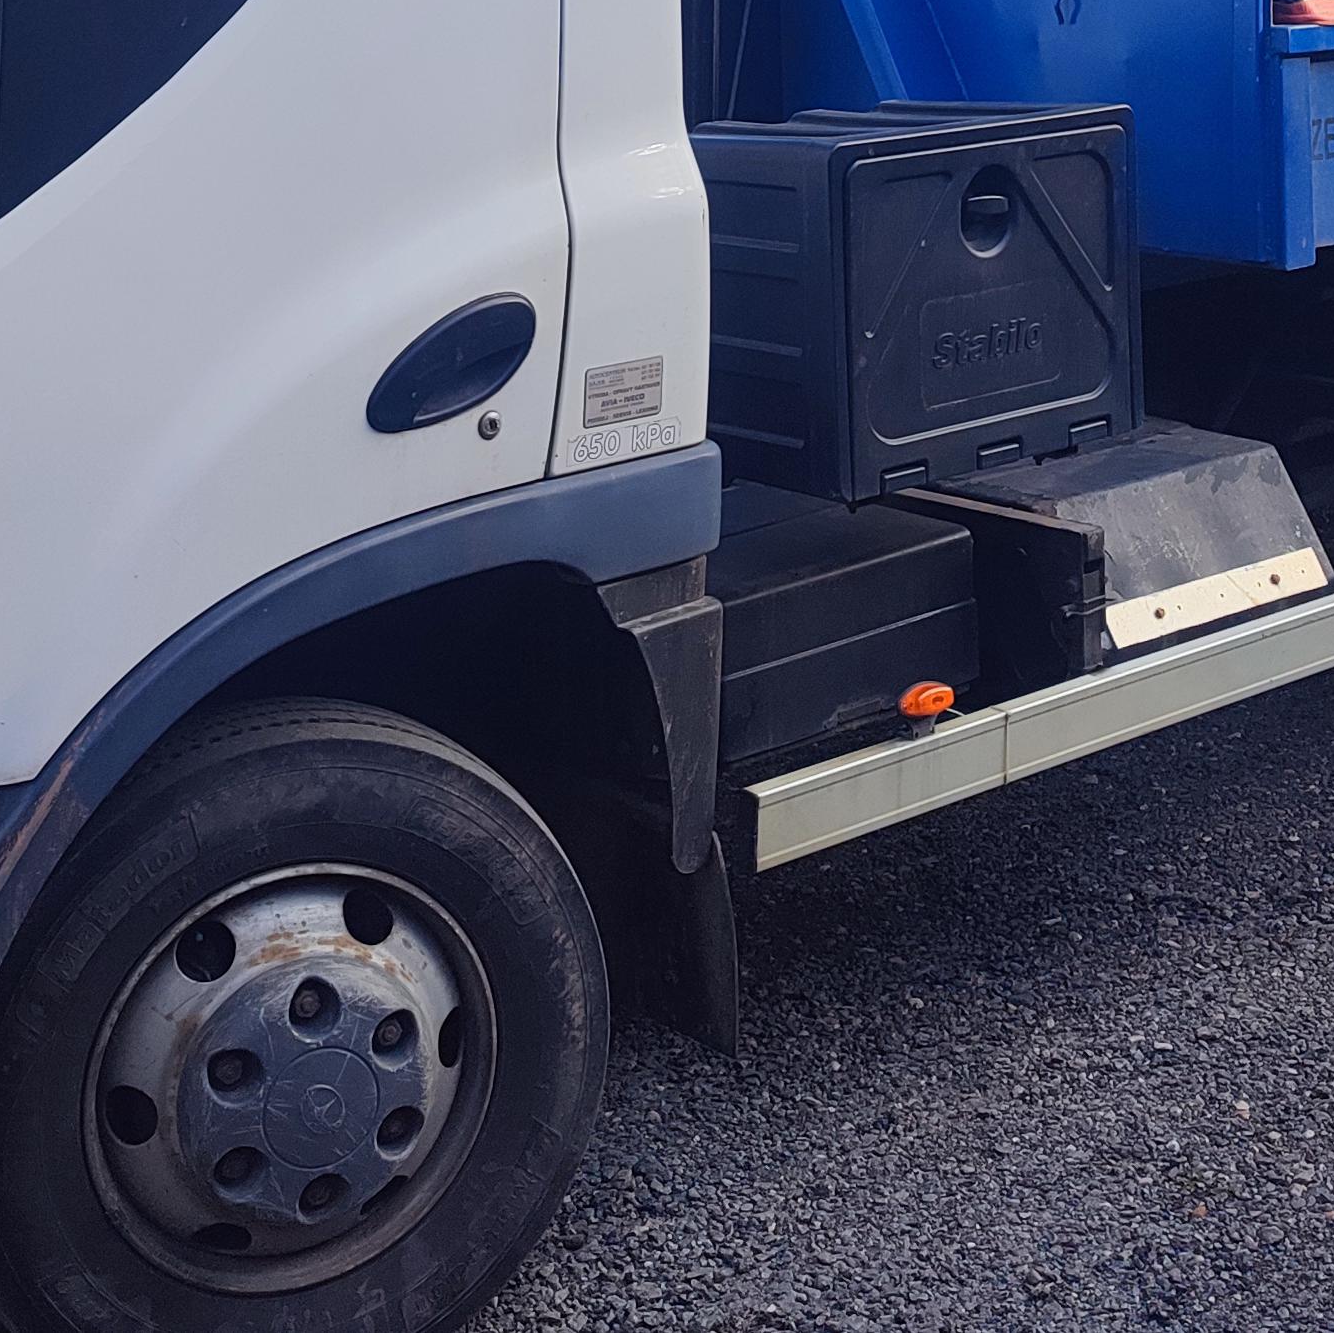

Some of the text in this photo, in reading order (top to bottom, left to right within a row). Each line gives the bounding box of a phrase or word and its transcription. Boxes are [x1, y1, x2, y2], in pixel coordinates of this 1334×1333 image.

[932, 317, 1043, 369] Stabilo
[573, 423, 676, 463] 650 kPa
